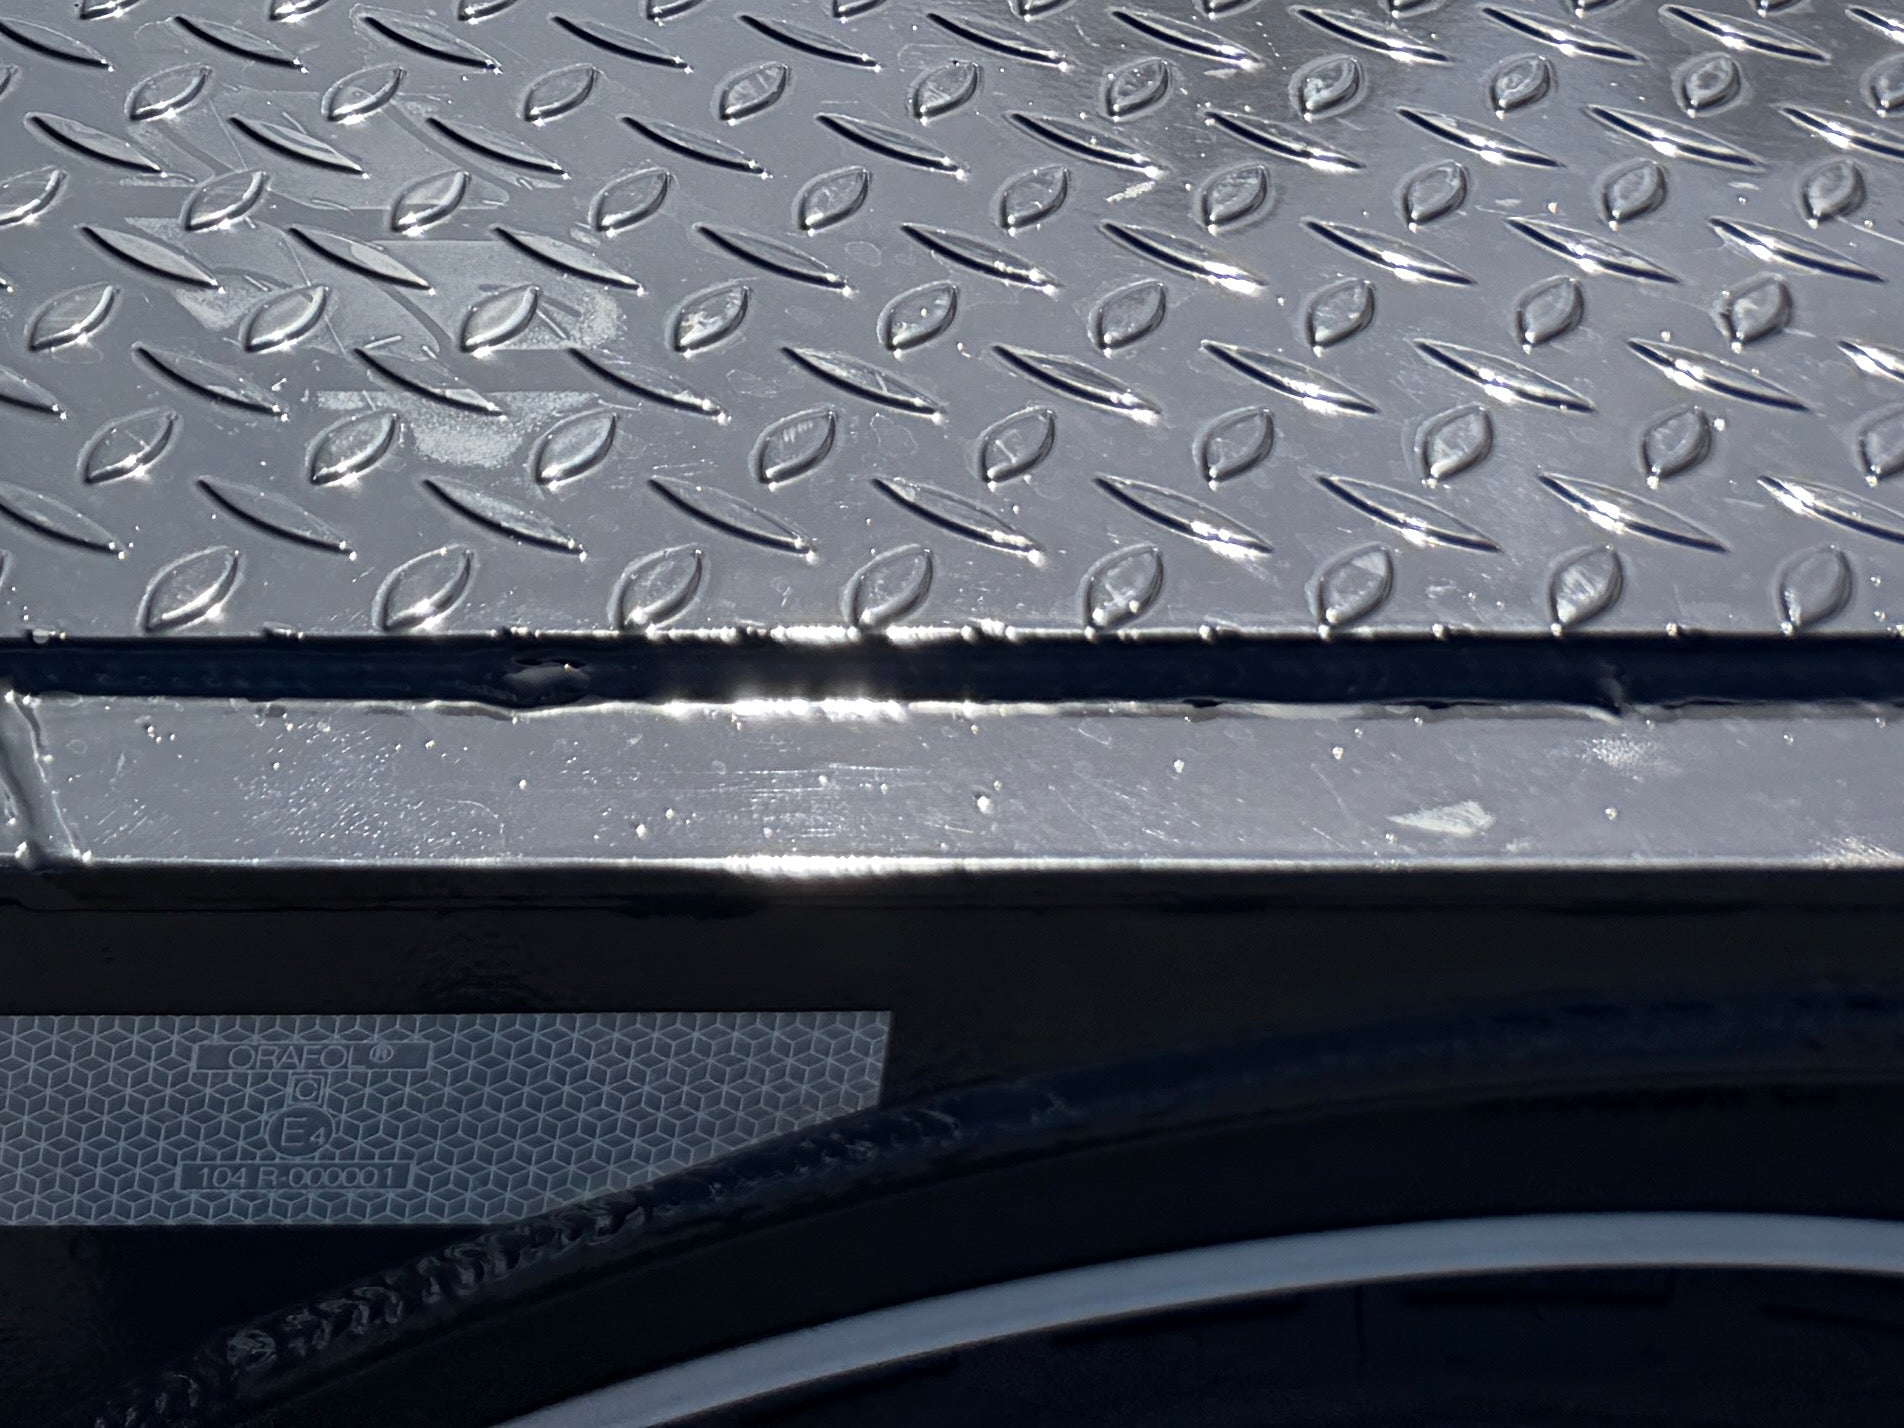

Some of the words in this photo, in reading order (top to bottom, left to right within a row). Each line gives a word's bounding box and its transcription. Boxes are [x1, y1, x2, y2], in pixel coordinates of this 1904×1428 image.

[296, 1080, 318, 1100] C
[199, 1166, 247, 1188] 104
[258, 1166, 393, 1188] R-000001
